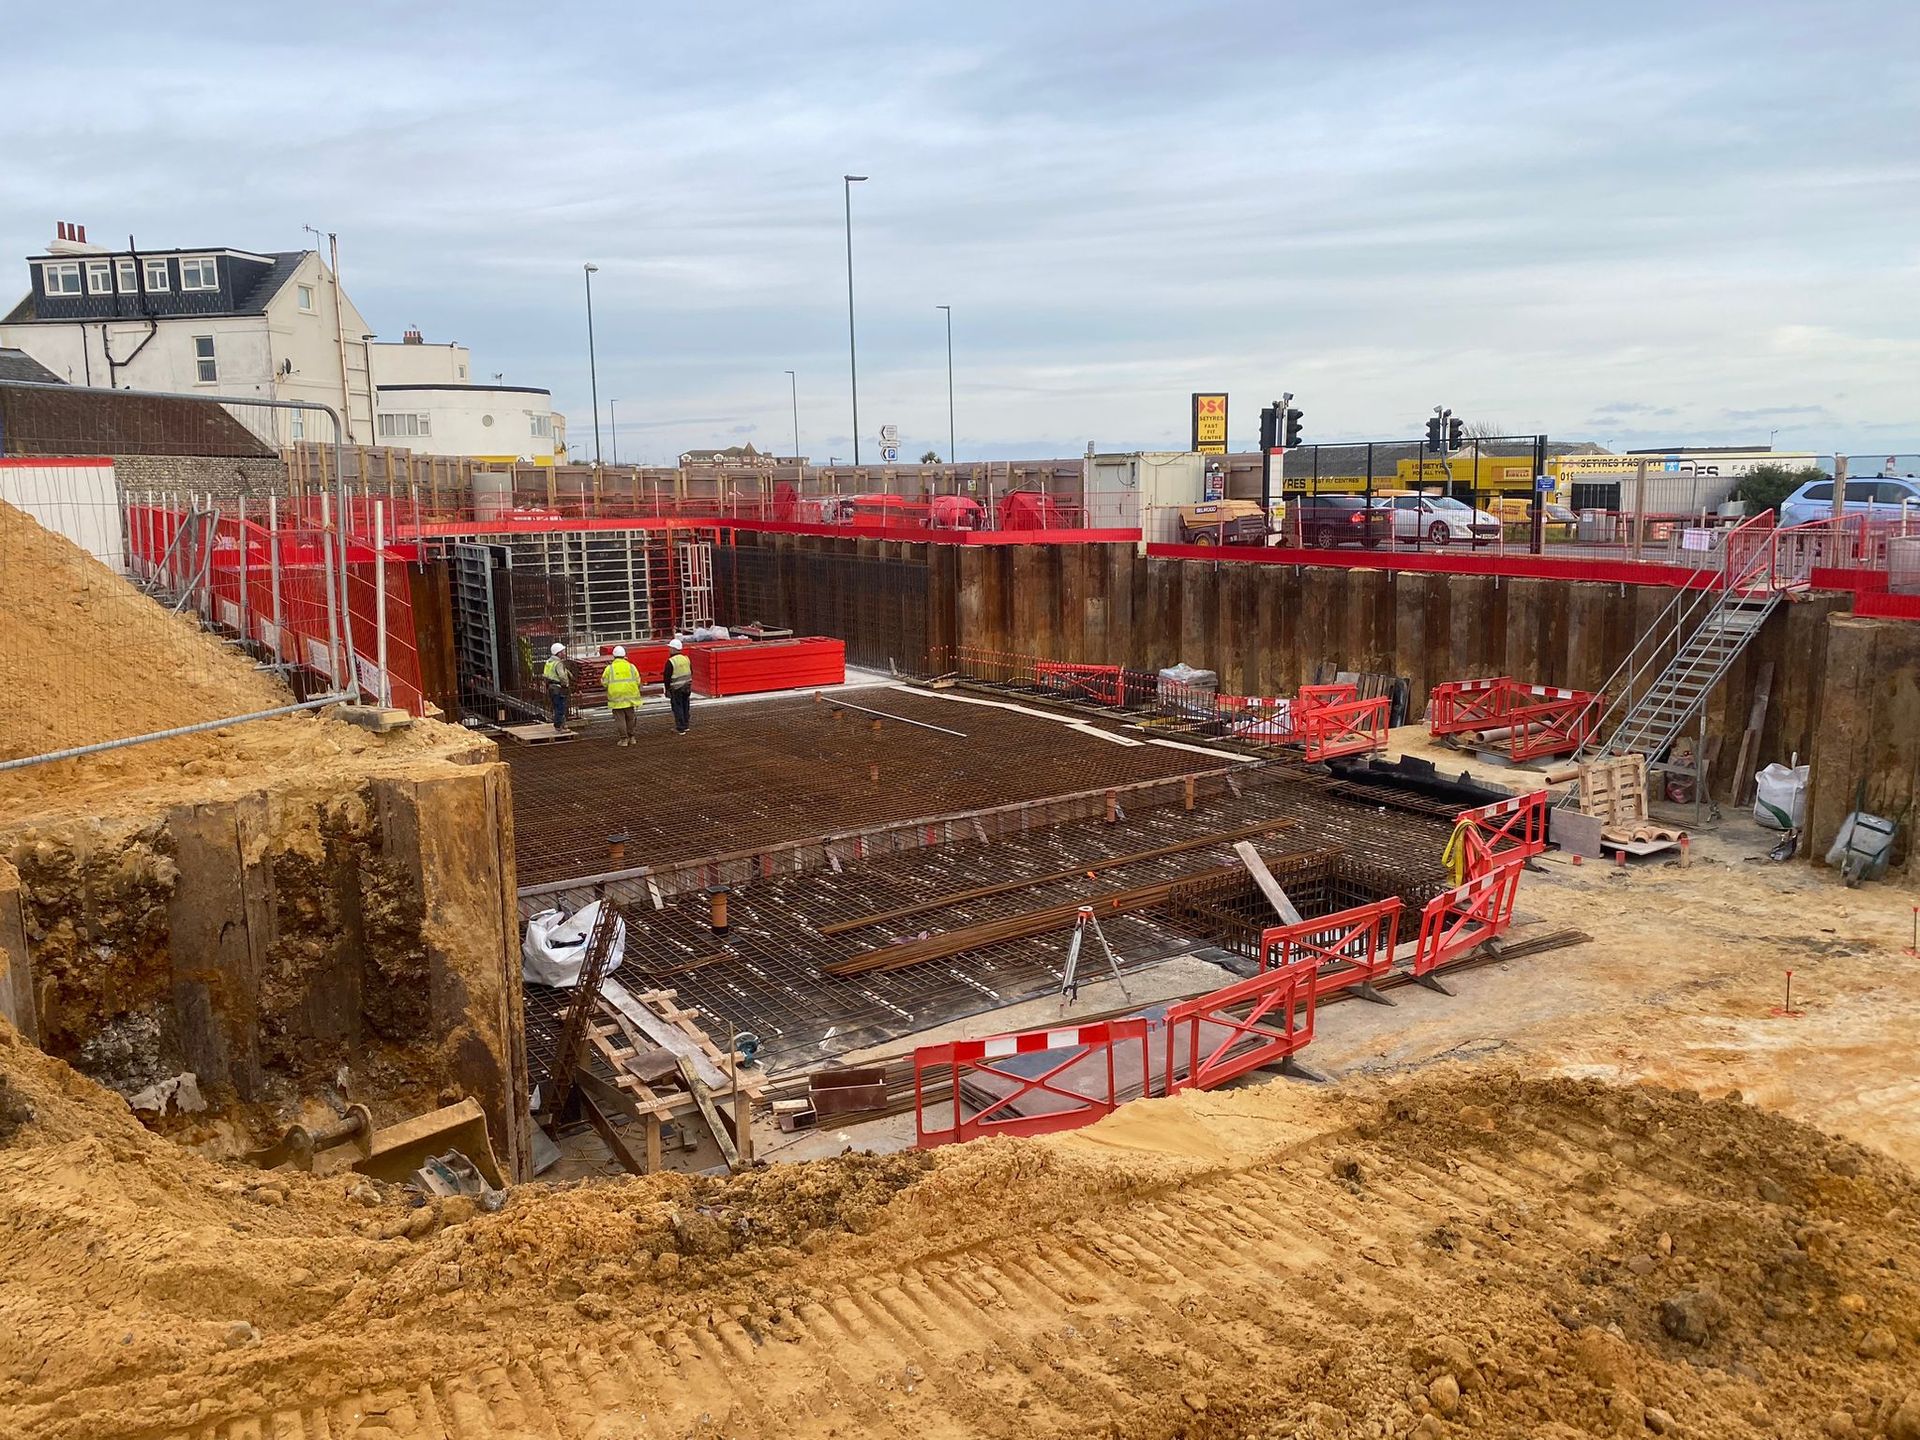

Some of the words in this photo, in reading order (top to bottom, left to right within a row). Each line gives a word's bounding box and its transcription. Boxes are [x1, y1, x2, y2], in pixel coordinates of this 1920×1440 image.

[1207, 400, 1216, 413] S
[1580, 459, 1619, 467] SETYRES
[1622, 458, 1639, 467] FAS
